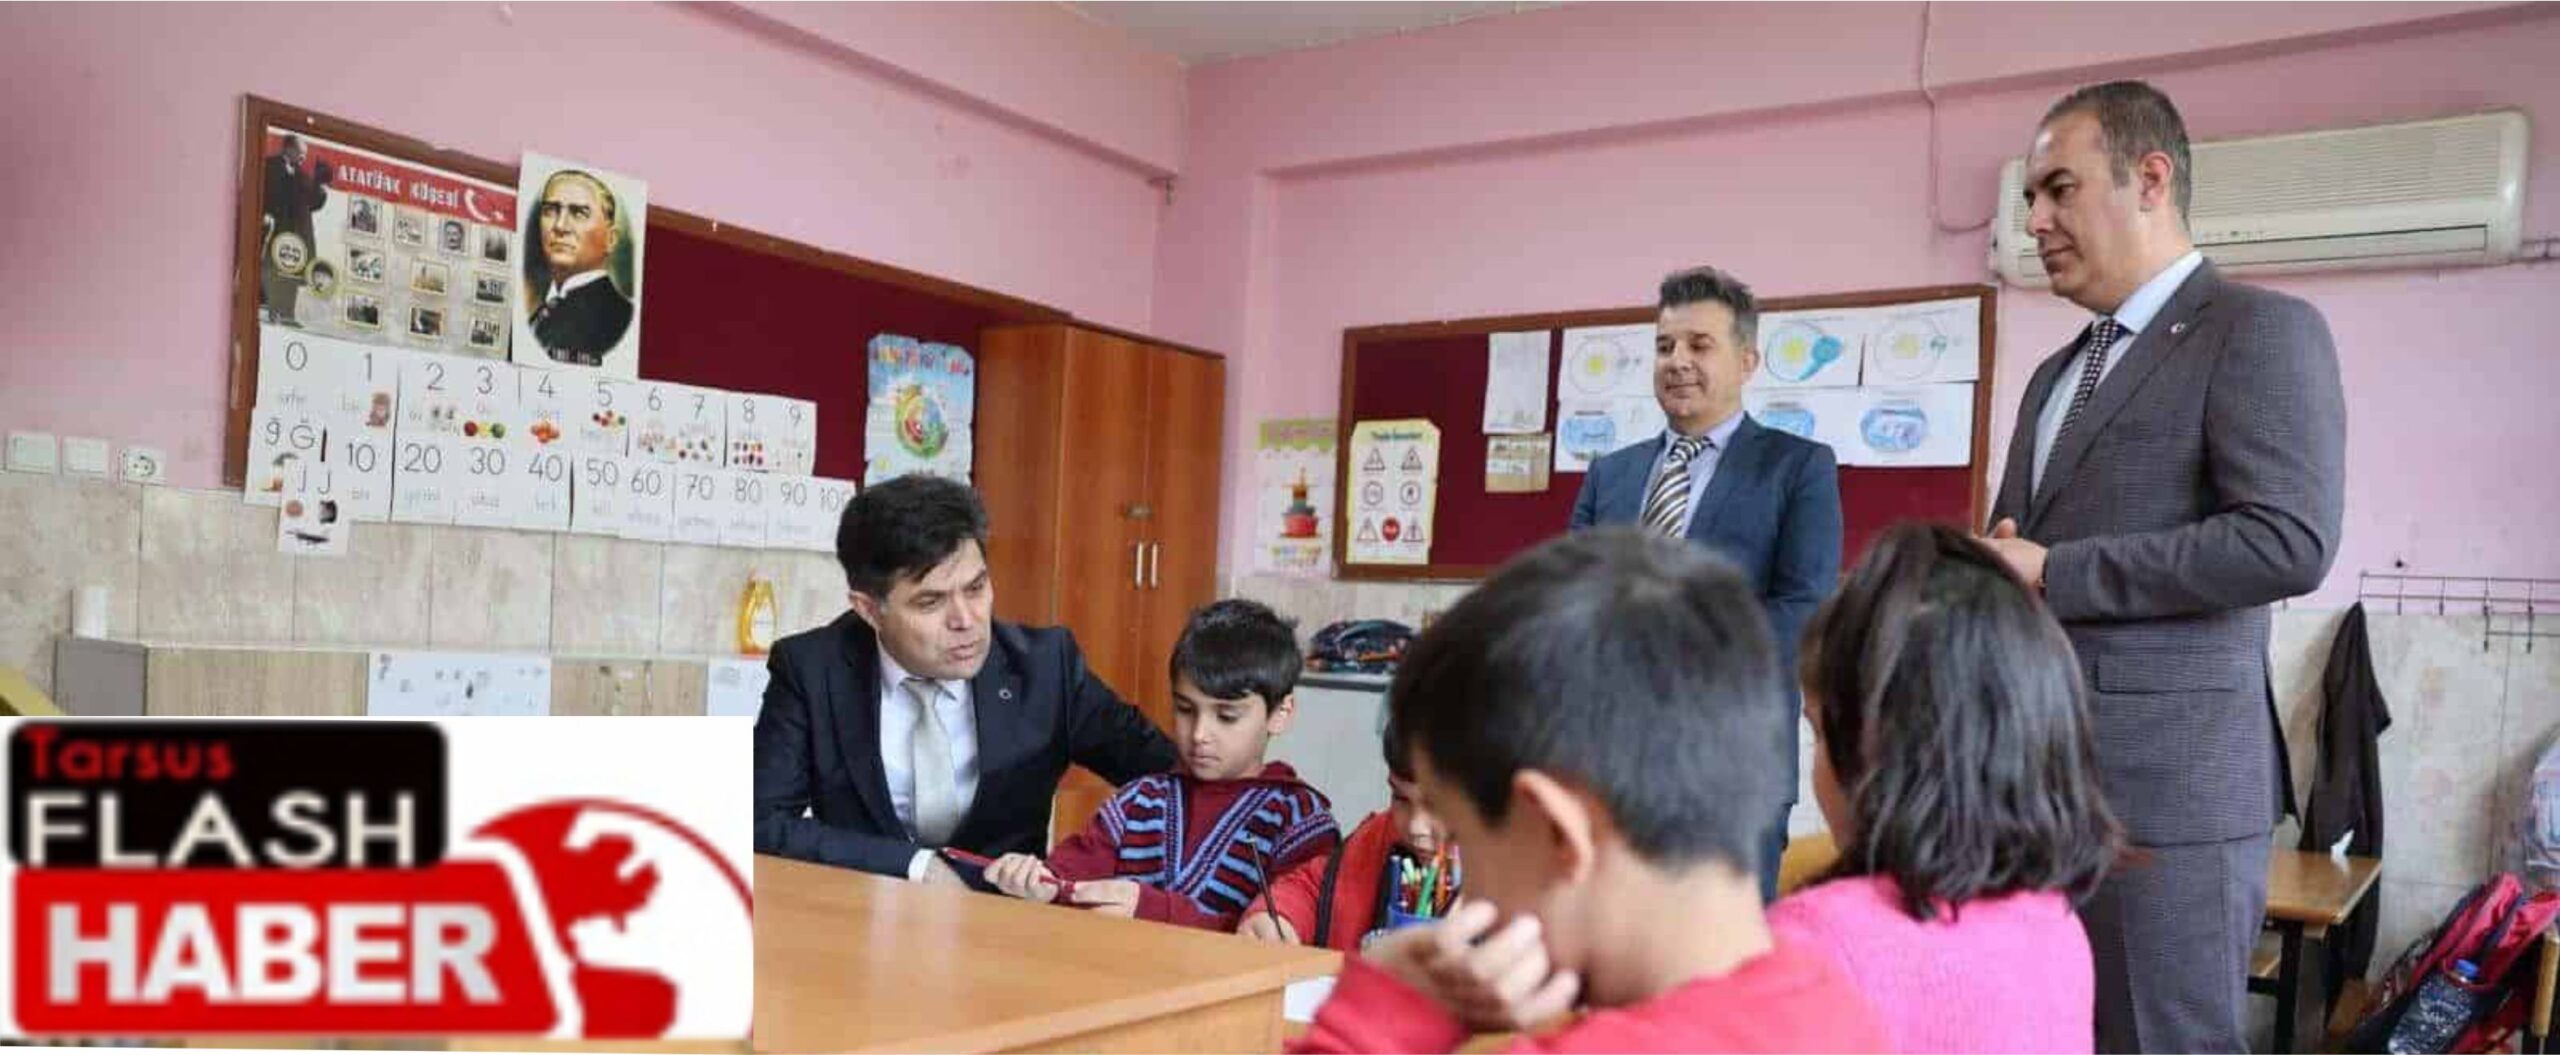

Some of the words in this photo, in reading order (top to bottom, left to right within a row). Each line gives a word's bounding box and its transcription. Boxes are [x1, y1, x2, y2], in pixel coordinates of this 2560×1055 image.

[286, 341, 307, 371] 0
[364, 352, 373, 382] 1
[426, 361, 446, 391] 2
[477, 365, 494, 395] 3
[538, 374, 555, 399] 4
[598, 381, 613, 407] 5
[648, 386, 662, 412] 6
[692, 394, 705, 419] 7
[742, 398, 756, 424] 8
[788, 404, 802, 427] 9
[347, 441, 376, 473] 10
[404, 442, 442, 474] 20
[469, 447, 506, 475] 30
[528, 454, 563, 483] 40
[586, 459, 619, 486] 50
[631, 468, 662, 496] 60
[686, 474, 715, 500] 70
[735, 478, 762, 503] 80
[780, 481, 808, 506] 90
